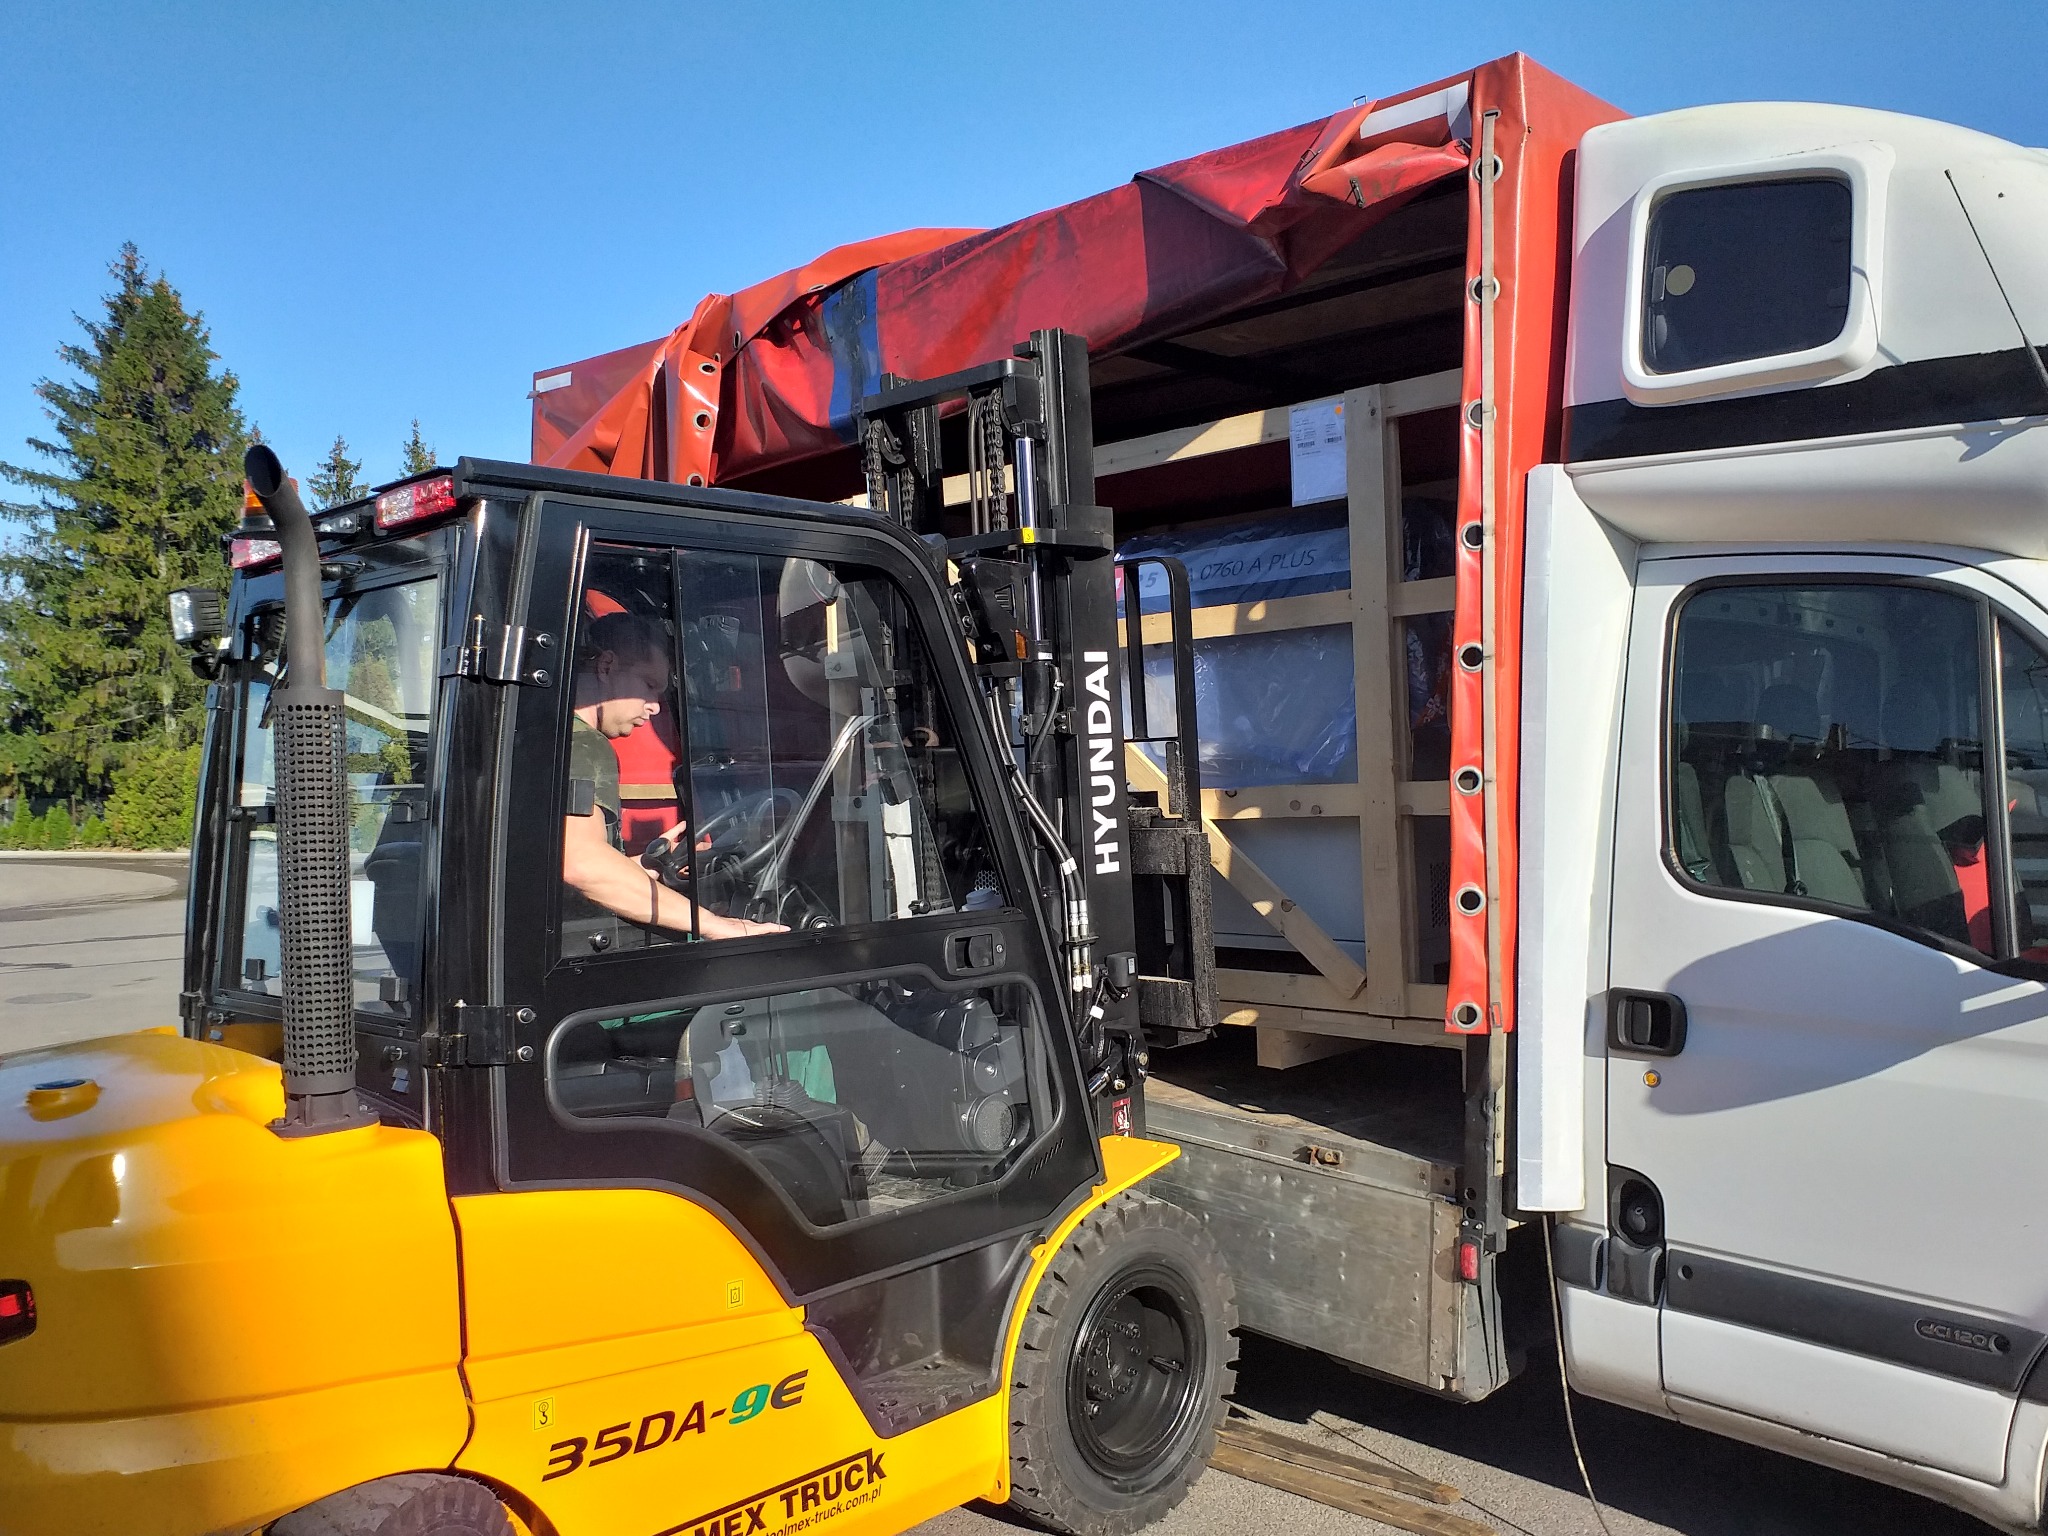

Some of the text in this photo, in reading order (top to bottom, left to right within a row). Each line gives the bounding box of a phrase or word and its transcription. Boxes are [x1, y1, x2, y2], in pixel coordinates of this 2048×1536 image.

[1200, 560, 1244, 580] 0760
[1247, 557, 1261, 574] A
[1268, 549, 1318, 571] PLUS
[1083, 650, 1120, 875] HYUNDAI
[1953, 1329, 1988, 1346] 120
[541, 1369, 809, 1482] 35DA-9E
[779, 1448, 887, 1519] TRUCK
